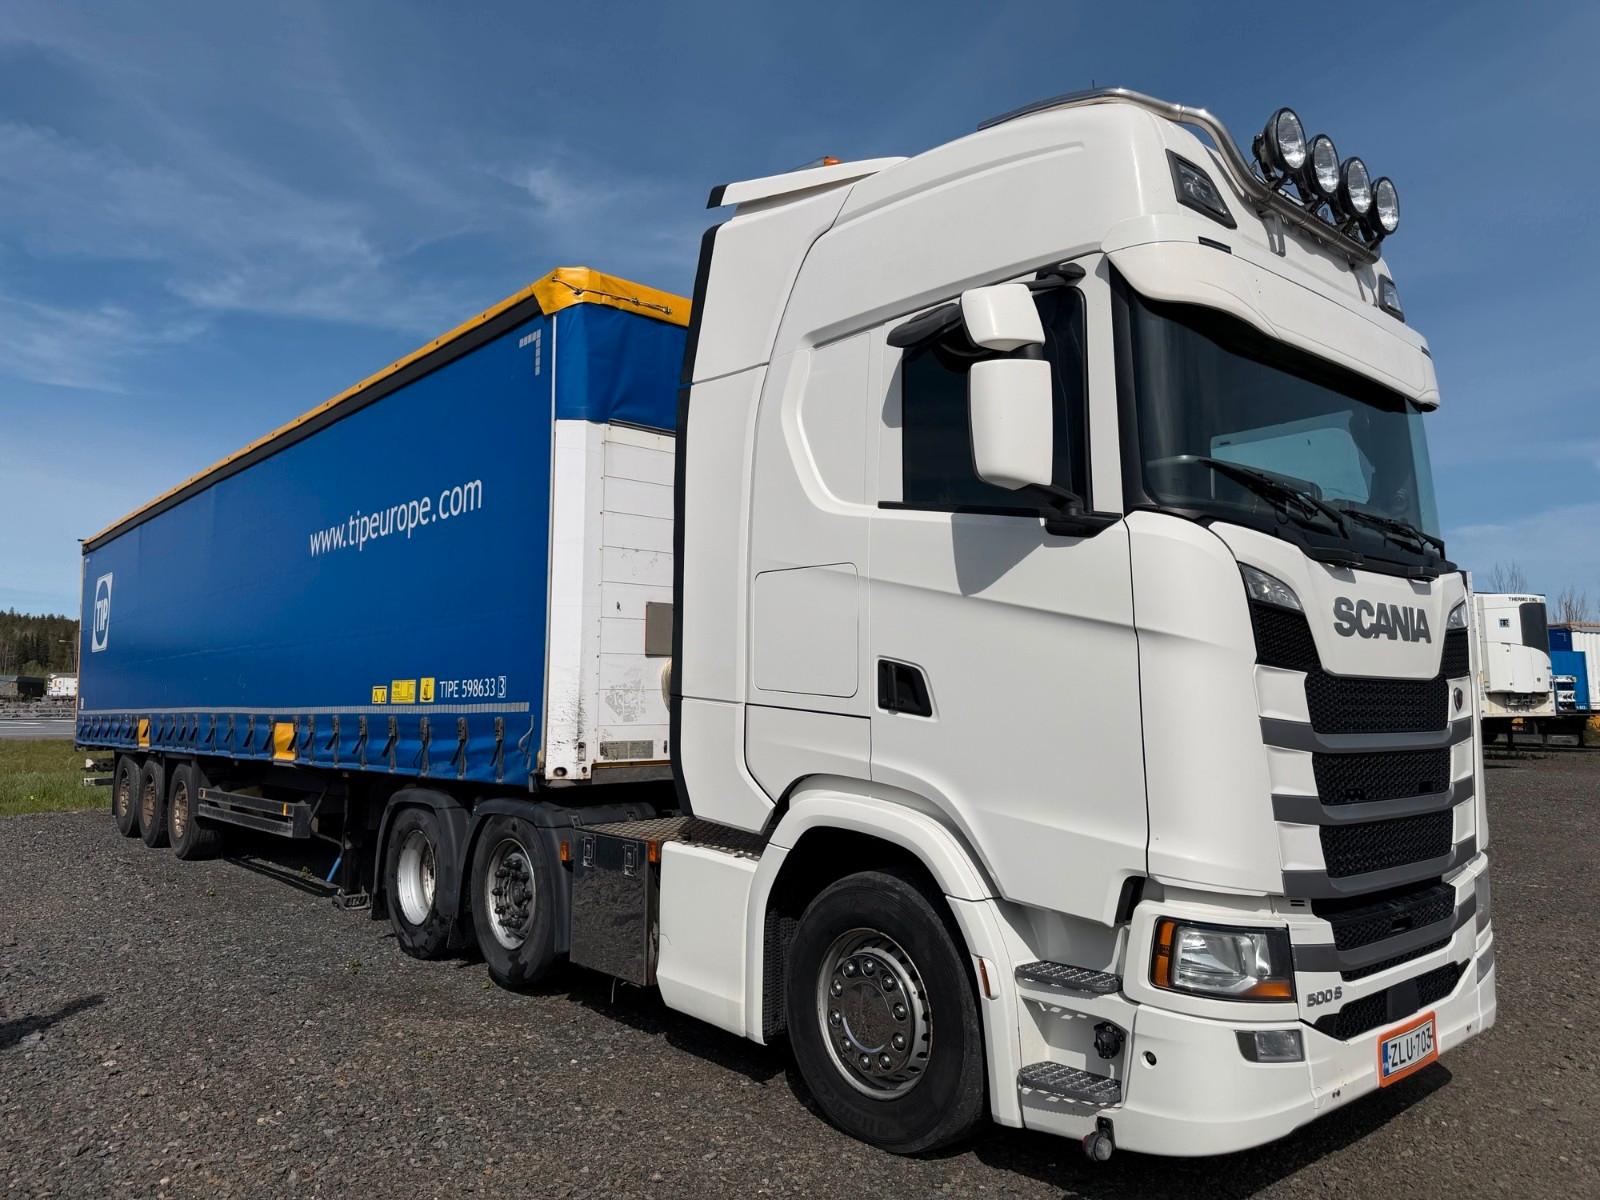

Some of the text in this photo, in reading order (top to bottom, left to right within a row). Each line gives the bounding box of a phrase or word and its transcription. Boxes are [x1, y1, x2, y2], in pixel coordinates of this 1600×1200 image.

[310, 479, 482, 557] www.tipeurope.com
[96, 598, 108, 632] TIP
[1333, 596, 1432, 644] SCANIA
[439, 680, 459, 698] TIPE
[461, 678, 496, 698] 598633
